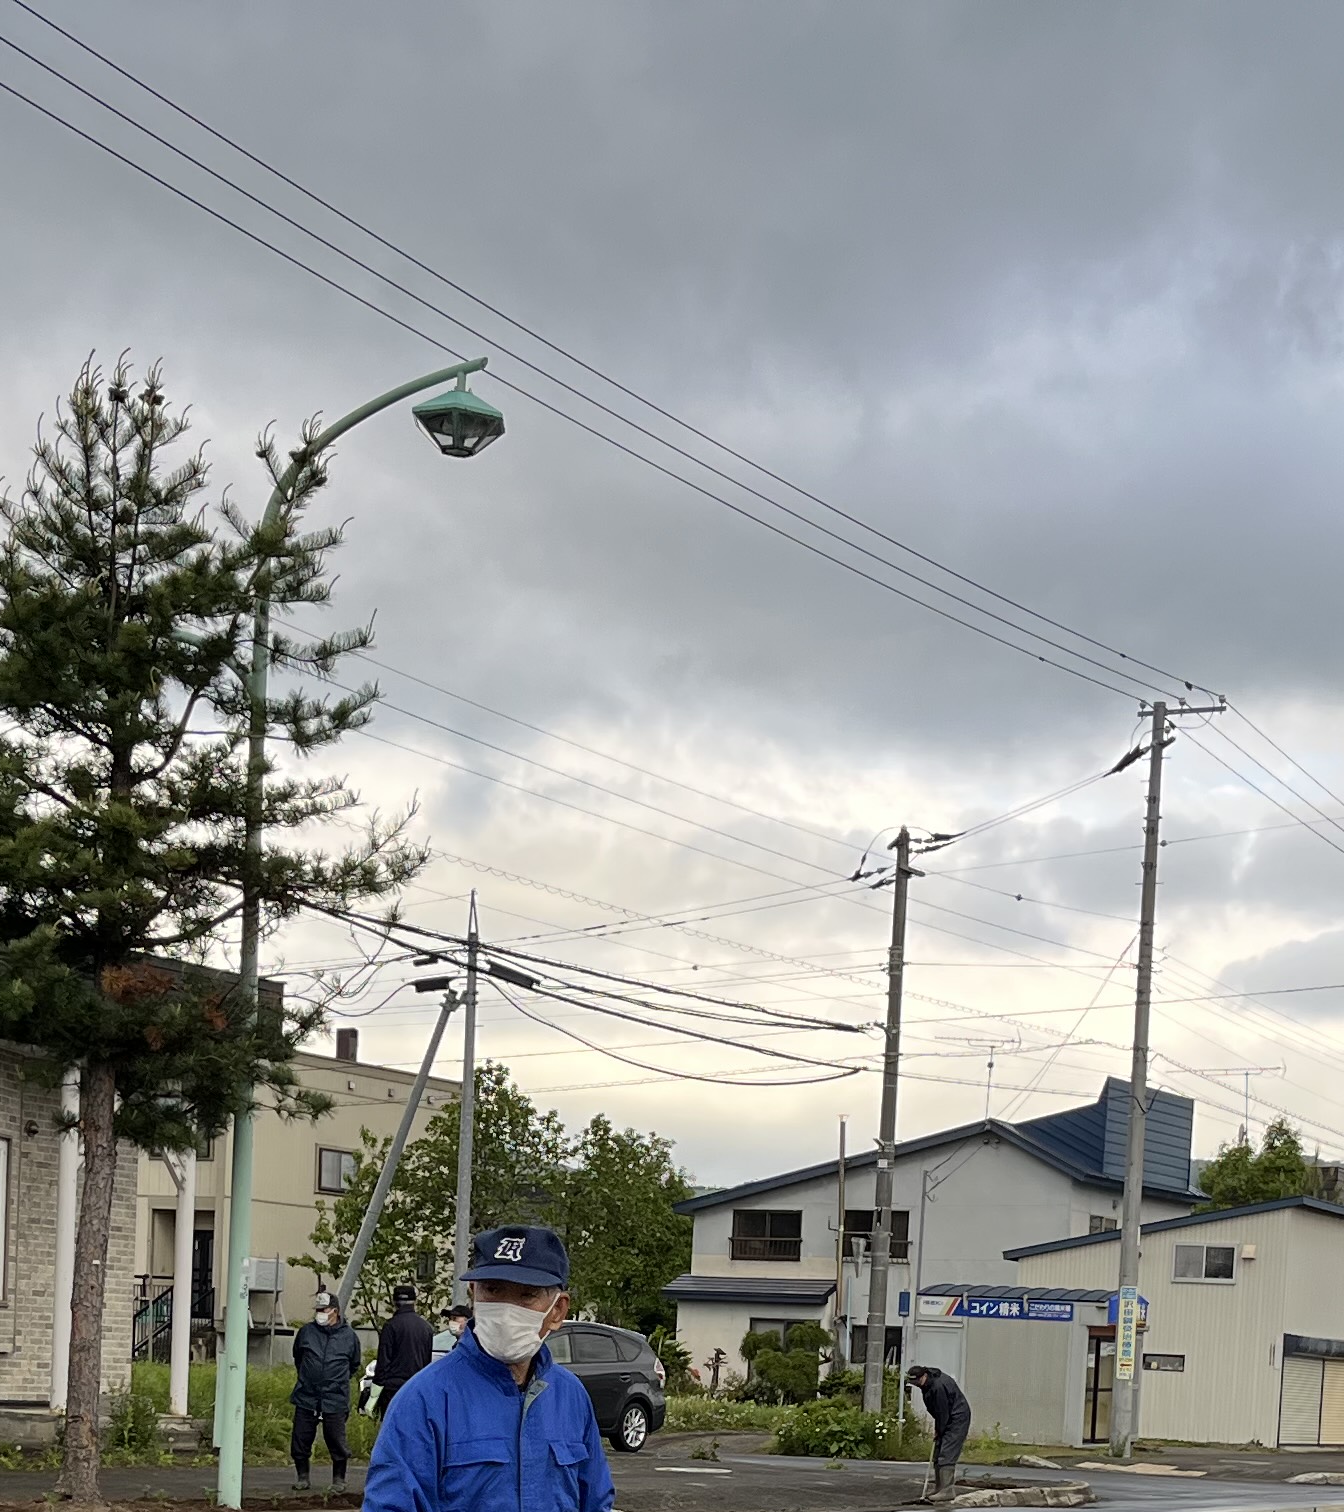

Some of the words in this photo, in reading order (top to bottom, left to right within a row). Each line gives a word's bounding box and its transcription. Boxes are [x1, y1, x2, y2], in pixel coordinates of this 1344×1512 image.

[970, 1302, 1020, 1316] コイン精米
